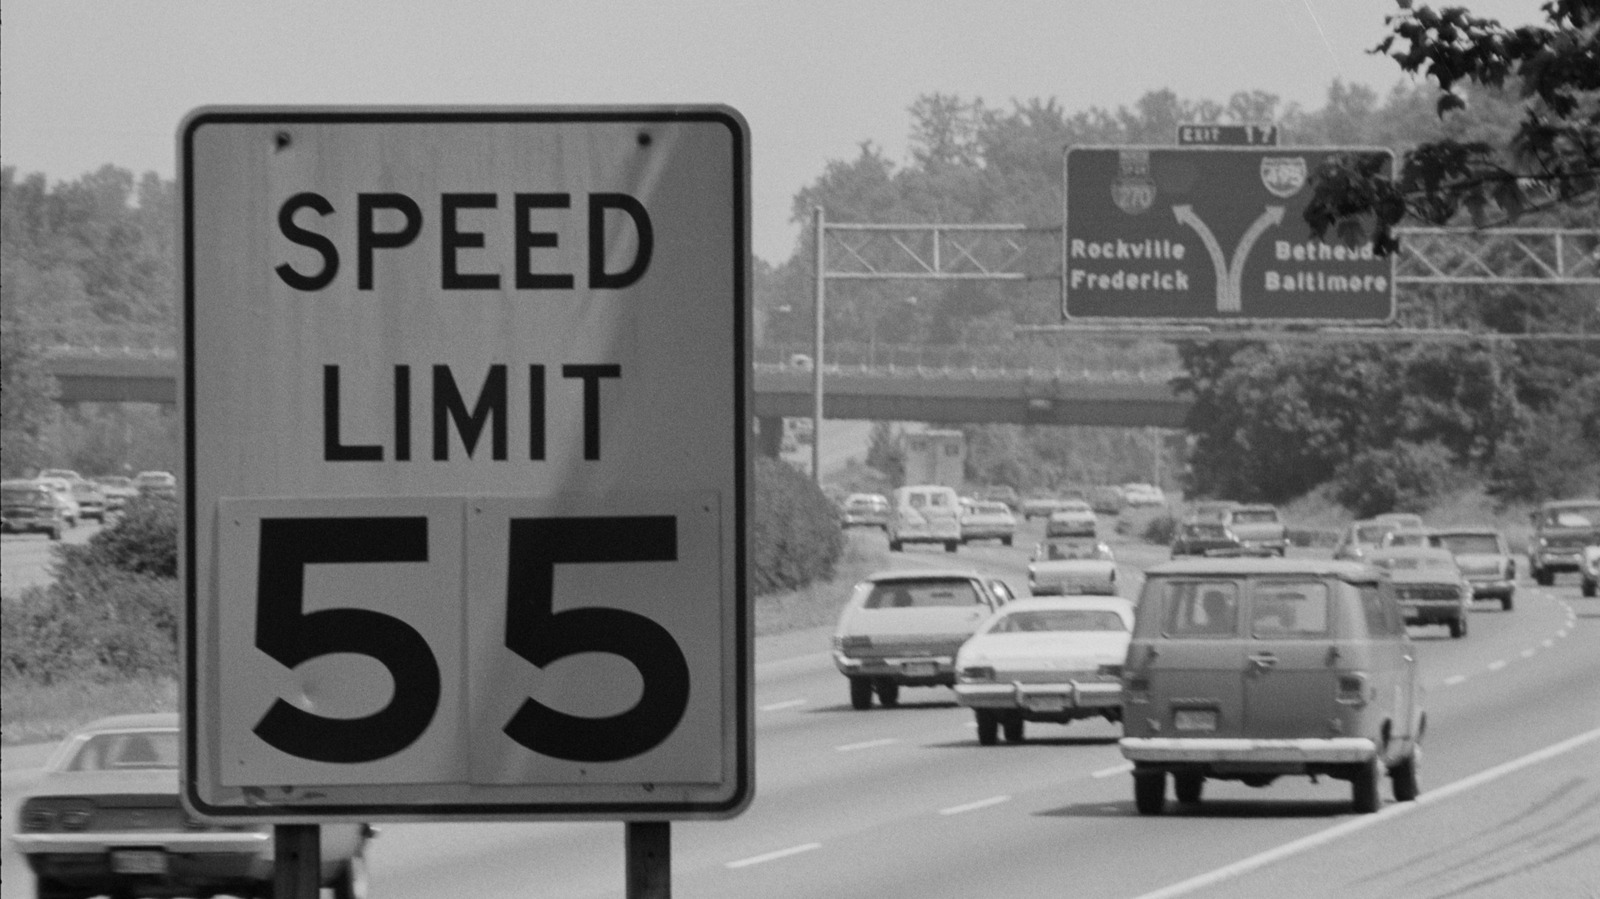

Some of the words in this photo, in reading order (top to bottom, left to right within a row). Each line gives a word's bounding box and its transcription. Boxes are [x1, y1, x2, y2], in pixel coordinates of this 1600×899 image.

[1182, 127, 1220, 142] EXIT
[1245, 125, 1272, 143] 17
[1263, 164, 1302, 187] 495
[274, 191, 654, 292] SPEED
[1071, 238, 1185, 259] Rockville
[1275, 240, 1385, 260] Bethesd
[1071, 269, 1189, 291] Frederick
[1265, 271, 1388, 292] Baltimore
[323, 363, 622, 462] LIMIT
[252, 515, 691, 764] 55
